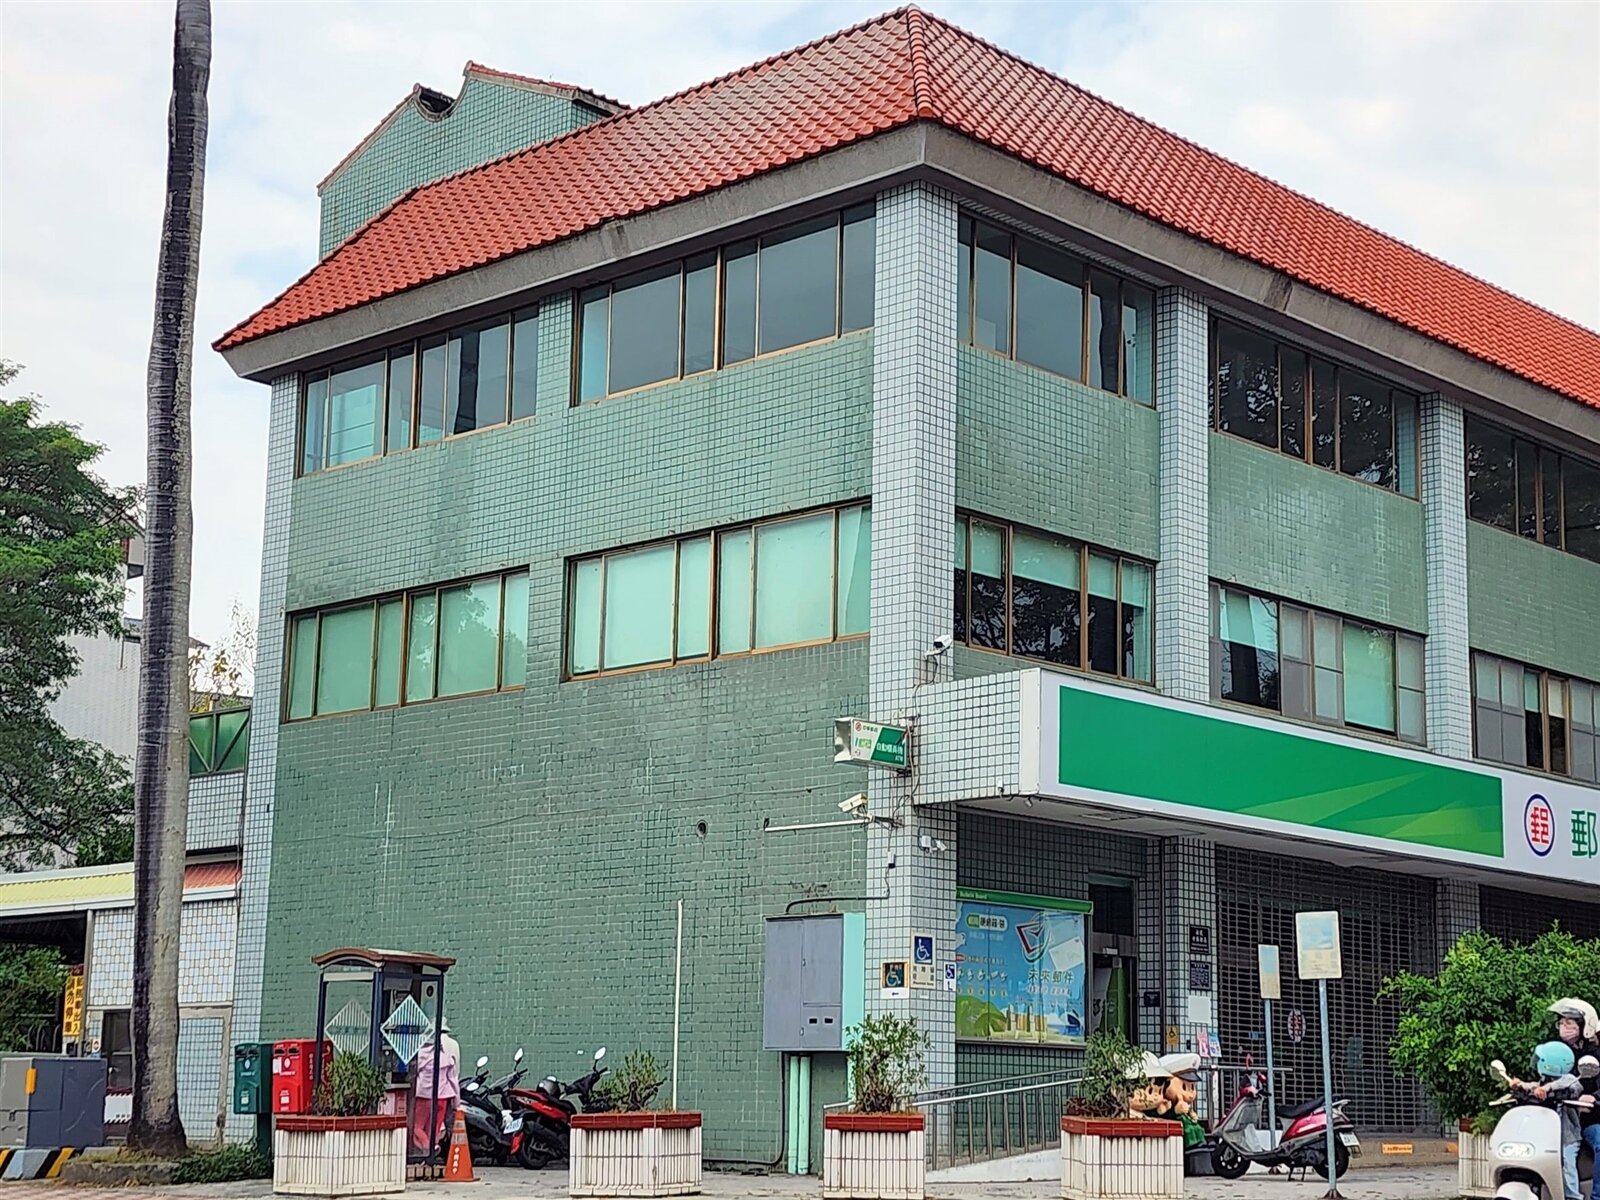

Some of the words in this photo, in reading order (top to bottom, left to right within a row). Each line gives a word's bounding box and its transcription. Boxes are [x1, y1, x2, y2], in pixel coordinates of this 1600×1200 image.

[1571, 810, 1598, 858] 郵
[1028, 968, 1073, 985] 未來郵件
